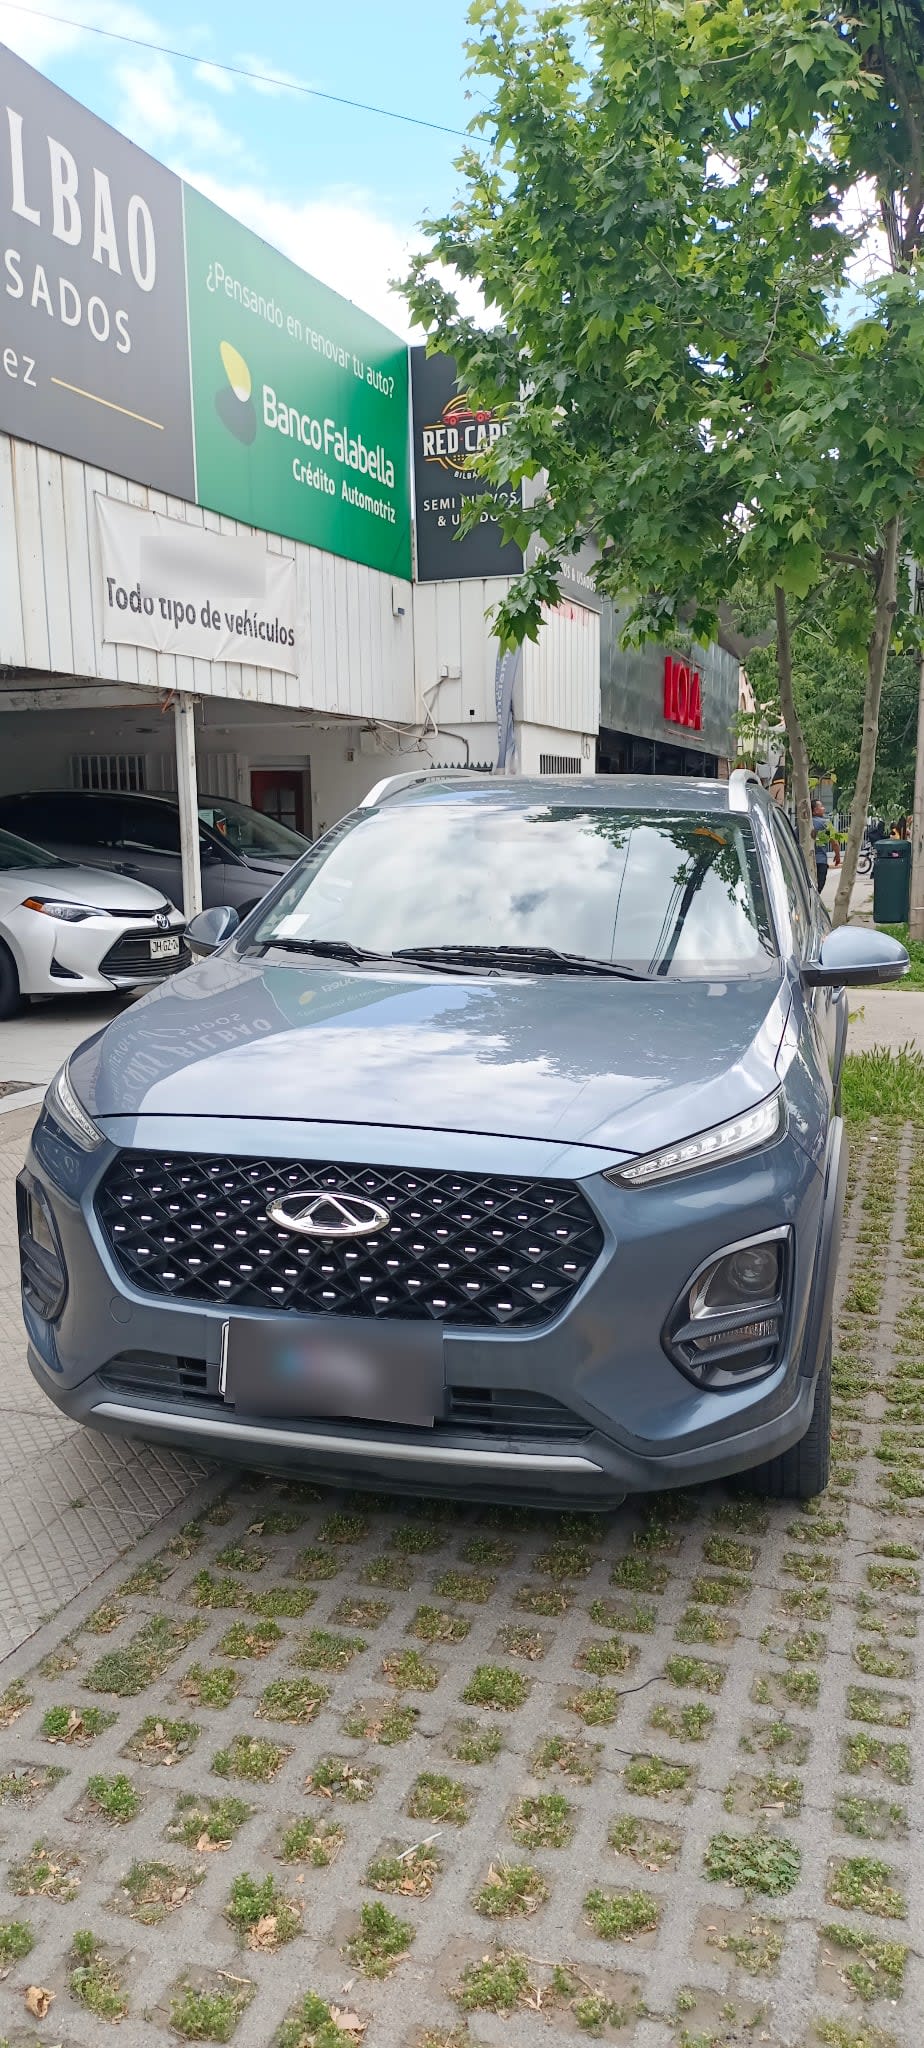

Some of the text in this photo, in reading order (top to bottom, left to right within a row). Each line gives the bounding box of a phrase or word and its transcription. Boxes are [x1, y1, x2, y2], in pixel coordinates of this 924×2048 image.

[6, 106, 156, 292] LBAO
[4, 248, 131, 354] SADOS
[206, 262, 395, 398] ¿Pensando en renovar tu auto?
[3, 347, 37, 387] ez
[422, 428, 459, 456] RED
[292, 458, 396, 524] Crédito Automotriz
[454, 470, 478, 480] BILBA
[423, 497, 456, 511] SEMI
[437, 515, 447, 527] &
[106, 576, 295, 647] Todo tipo de vehículos
